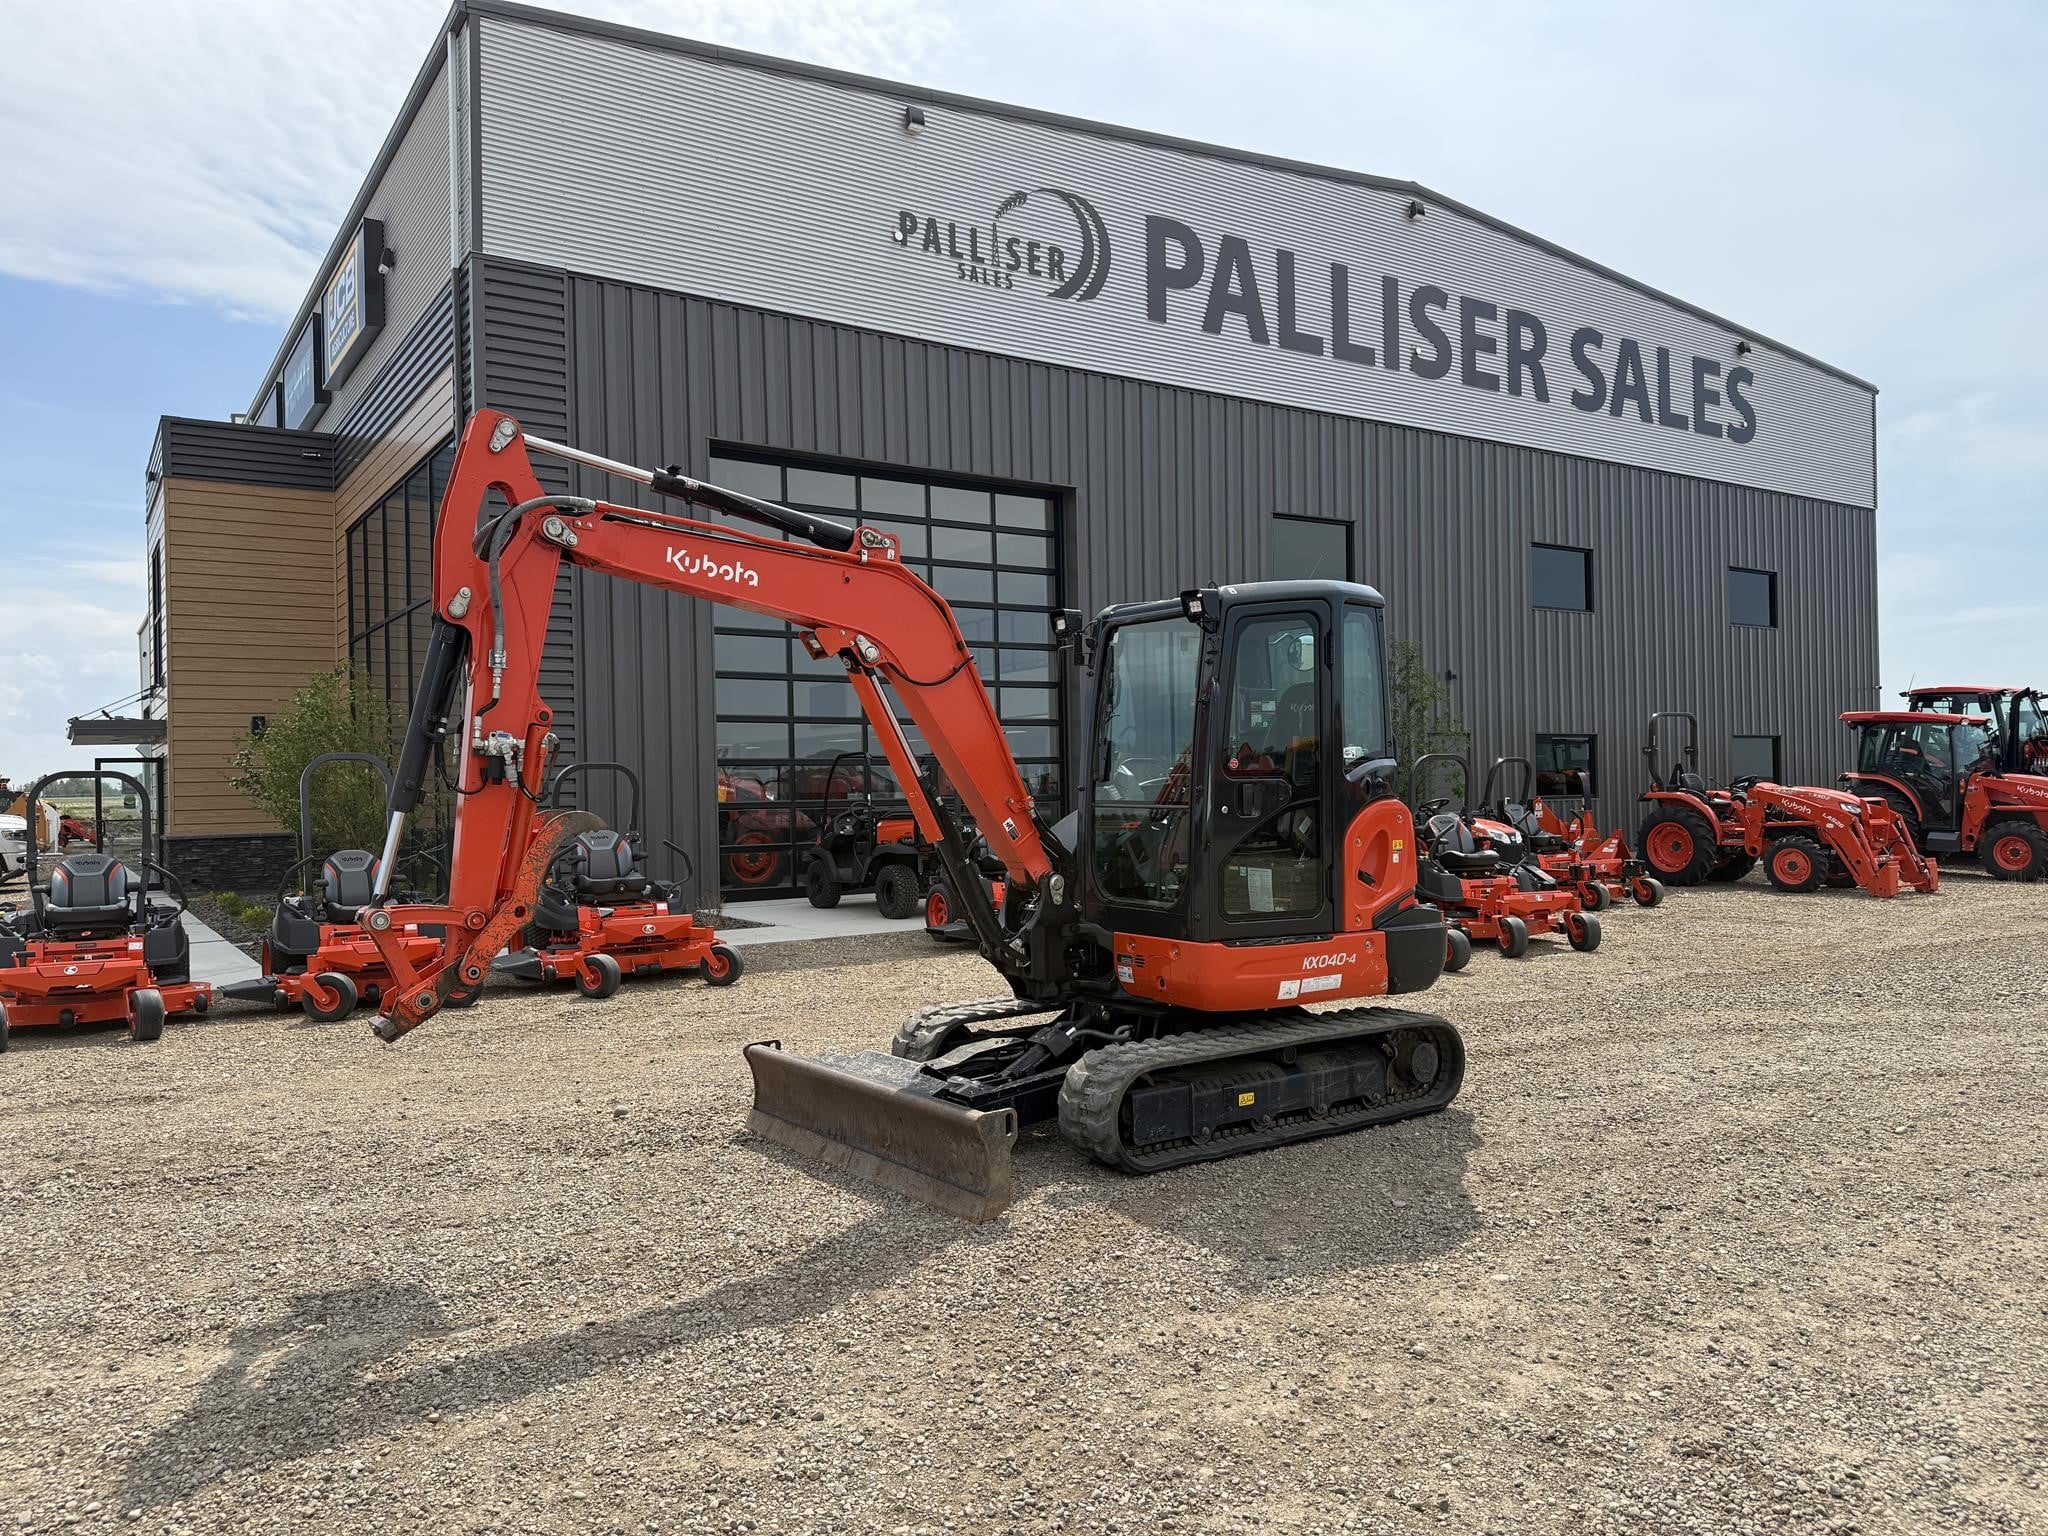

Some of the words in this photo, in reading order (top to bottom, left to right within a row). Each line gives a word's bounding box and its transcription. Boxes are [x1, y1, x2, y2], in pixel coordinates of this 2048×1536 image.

[899, 211, 1065, 282] PALLISER
[330, 256, 355, 331] JCB
[958, 262, 1013, 289] SALES
[1146, 215, 1550, 403] PALLISER
[1571, 327, 1757, 444] SALES
[666, 546, 759, 587] Kubota
[1781, 798, 1812, 815] Kubota
[1302, 953, 1357, 970] KX040-4
